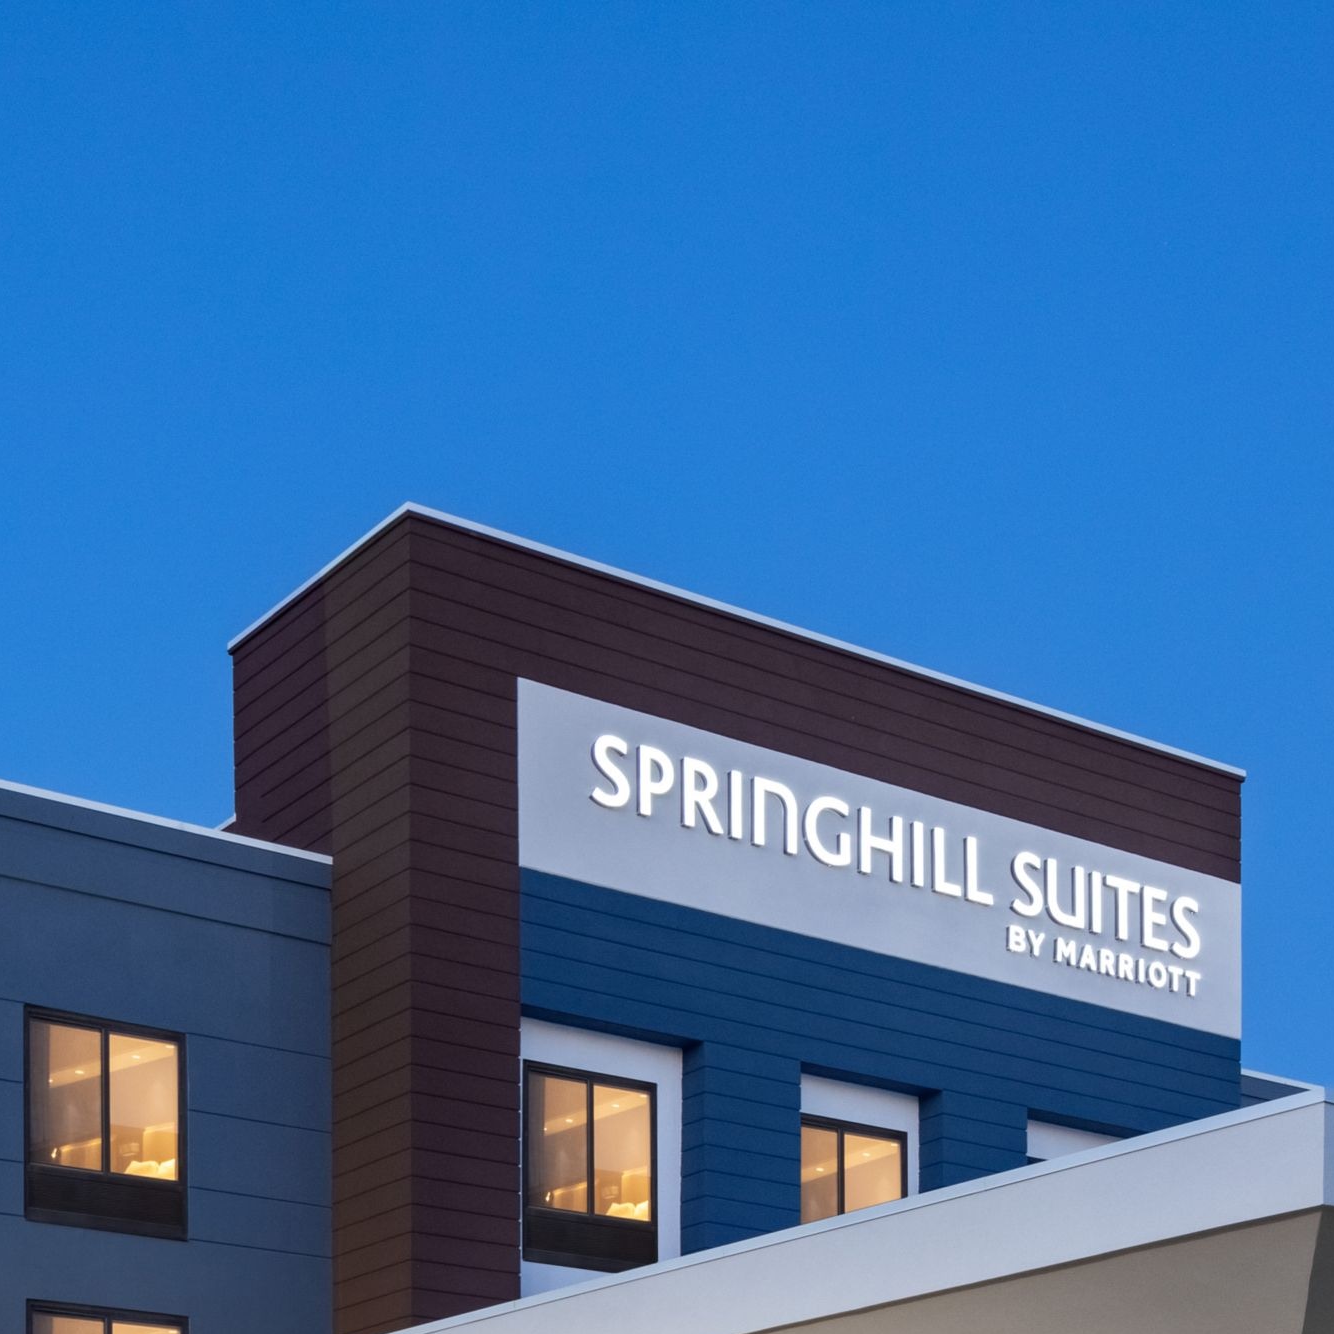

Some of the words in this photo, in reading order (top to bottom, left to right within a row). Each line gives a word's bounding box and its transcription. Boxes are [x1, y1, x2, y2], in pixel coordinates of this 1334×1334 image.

[590, 734, 994, 905] SPRINGHILL
[1010, 851, 1202, 960] SUITES
[1007, 924, 1046, 957] BY
[1054, 937, 1202, 997] MARRIOTT
